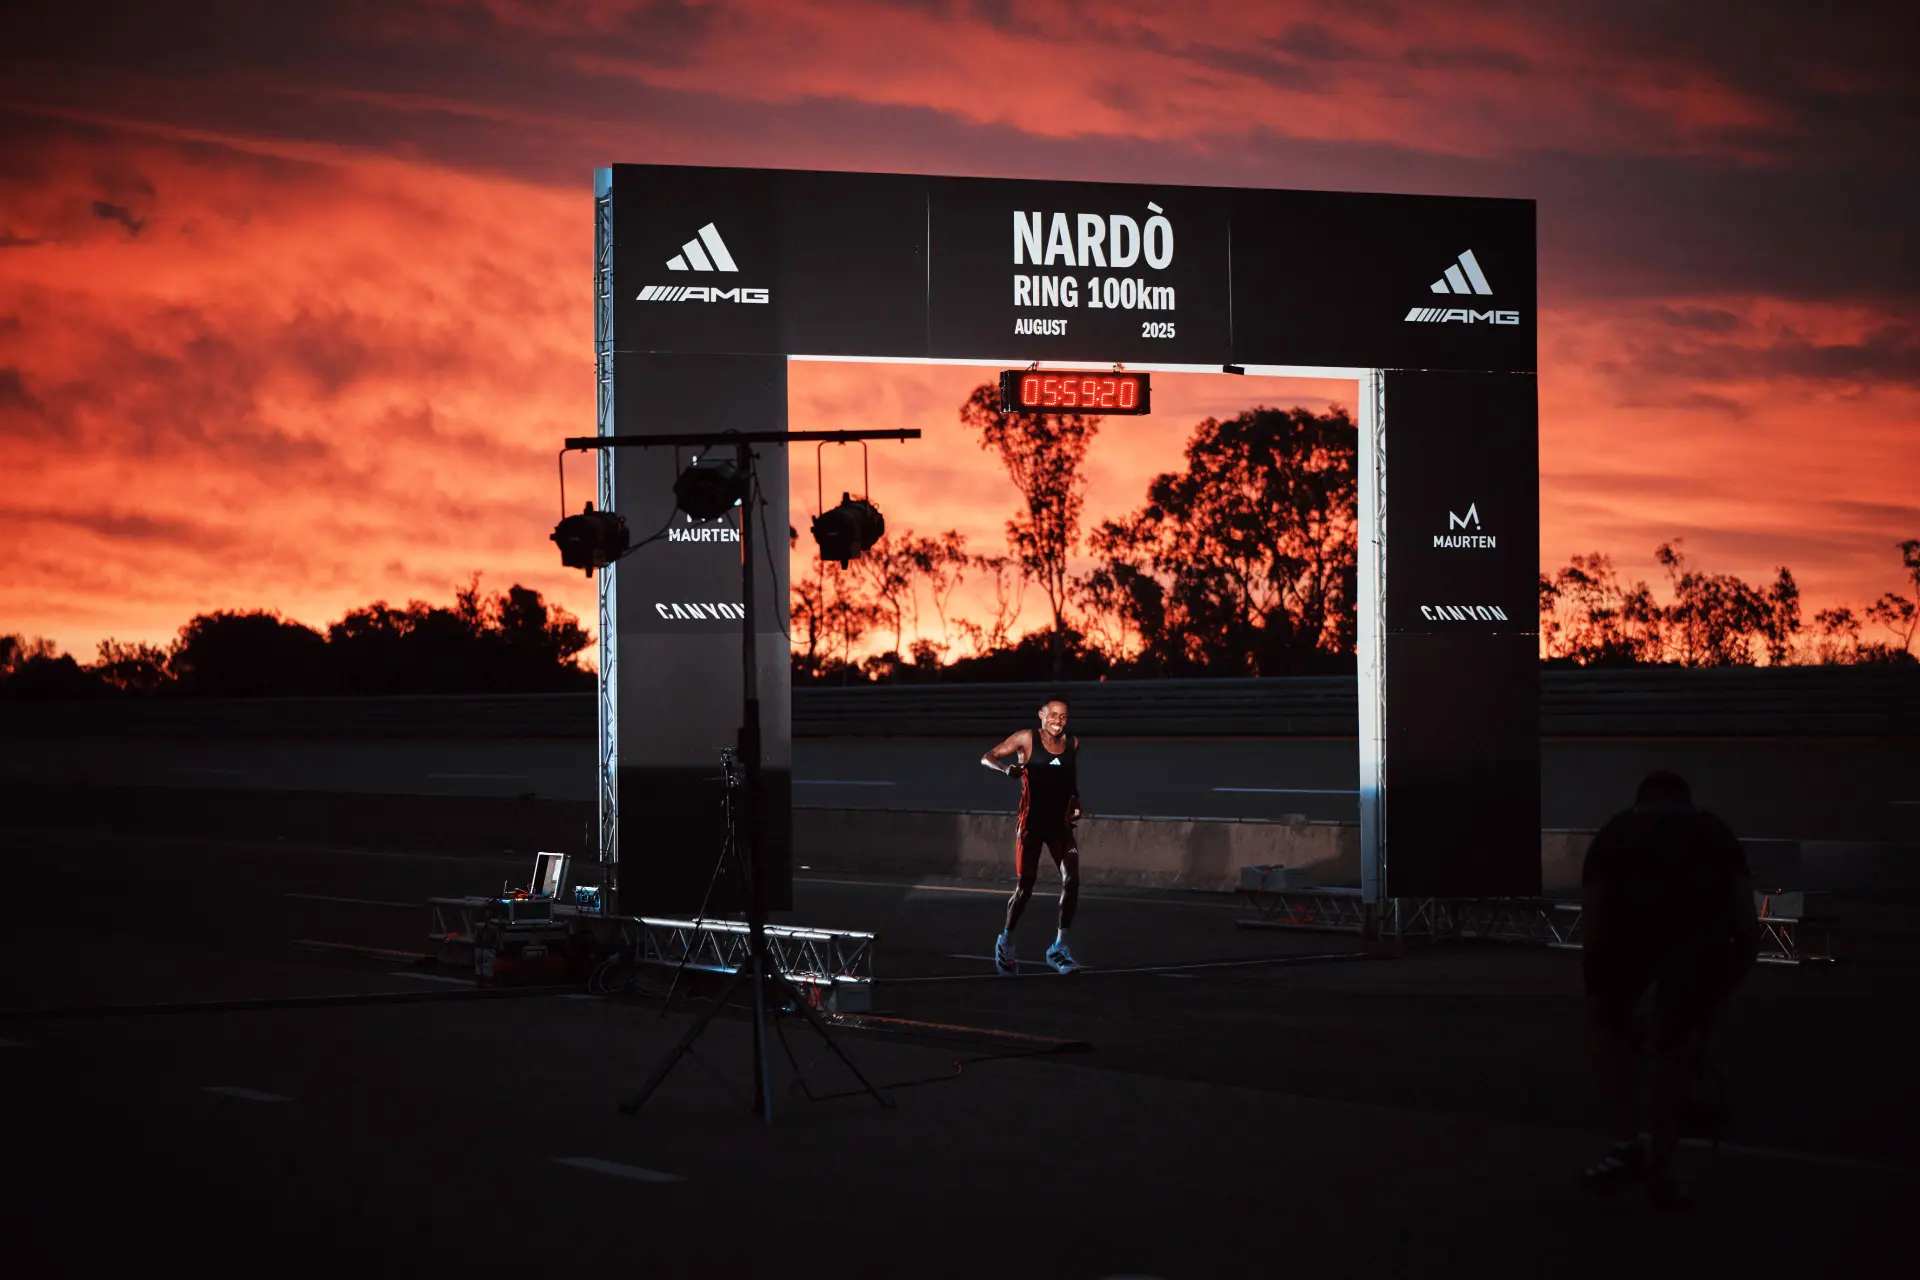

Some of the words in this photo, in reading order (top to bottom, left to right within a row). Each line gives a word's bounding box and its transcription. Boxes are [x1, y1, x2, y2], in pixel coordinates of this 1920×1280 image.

[1013, 202, 1174, 270] NARDÒ
[1013, 274, 1079, 308] RING
[1087, 277, 1176, 312] 100km
[1014, 318, 1068, 336] AUGUST
[1141, 321, 1176, 339] 2025
[1023, 378, 1135, 408] 05:59:20
[668, 528, 741, 543] MAURTEN
[1433, 535, 1496, 549] MAURTEN
[1420, 605, 1509, 621] CANYON
